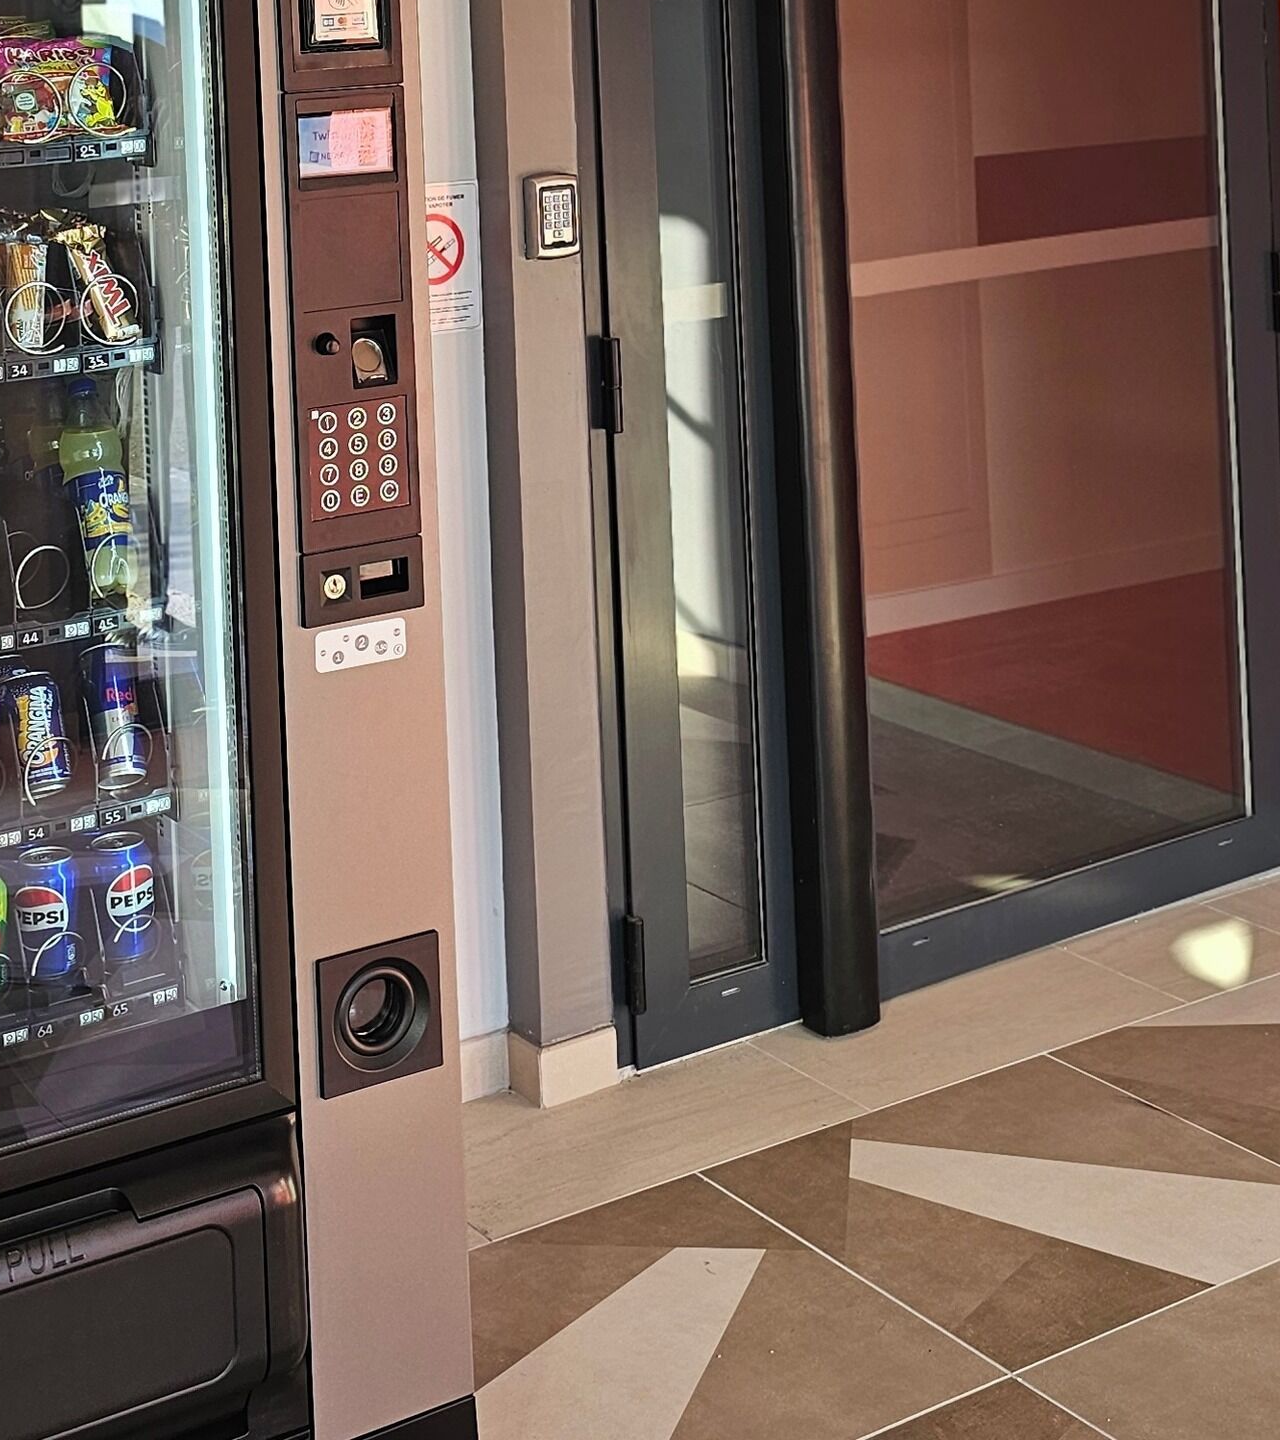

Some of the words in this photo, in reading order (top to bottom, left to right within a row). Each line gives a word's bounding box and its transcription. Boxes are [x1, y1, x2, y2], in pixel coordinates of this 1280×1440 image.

[5, 46, 95, 64] HARIBO
[79, 145, 98, 157] 25
[88, 249, 131, 325] TWIX
[88, 355, 106, 369] 35
[11, 365, 28, 377] 34
[324, 416, 332, 430] 1
[353, 412, 362, 426] 2
[382, 407, 391, 420] 3
[323, 442, 332, 455] 4
[353, 437, 363, 450] 5
[383, 433, 392, 446] 6
[325, 468, 334, 481] 7
[355, 463, 363, 477] 8
[384, 459, 392, 472] 9
[327, 494, 335, 507] 0
[356, 489, 364, 502] E
[383, 483, 395, 497] C
[98, 618, 117, 632] 45
[22, 632, 39, 645] 44
[105, 688, 133, 702] Red
[23, 686, 47, 764] ORANGINA
[104, 810, 121, 824] 55
[27, 828, 45, 841] 54
[112, 1003, 129, 1017] 65
[37, 1024, 54, 1038] 64
[4, 1232, 86, 1284] PULL
